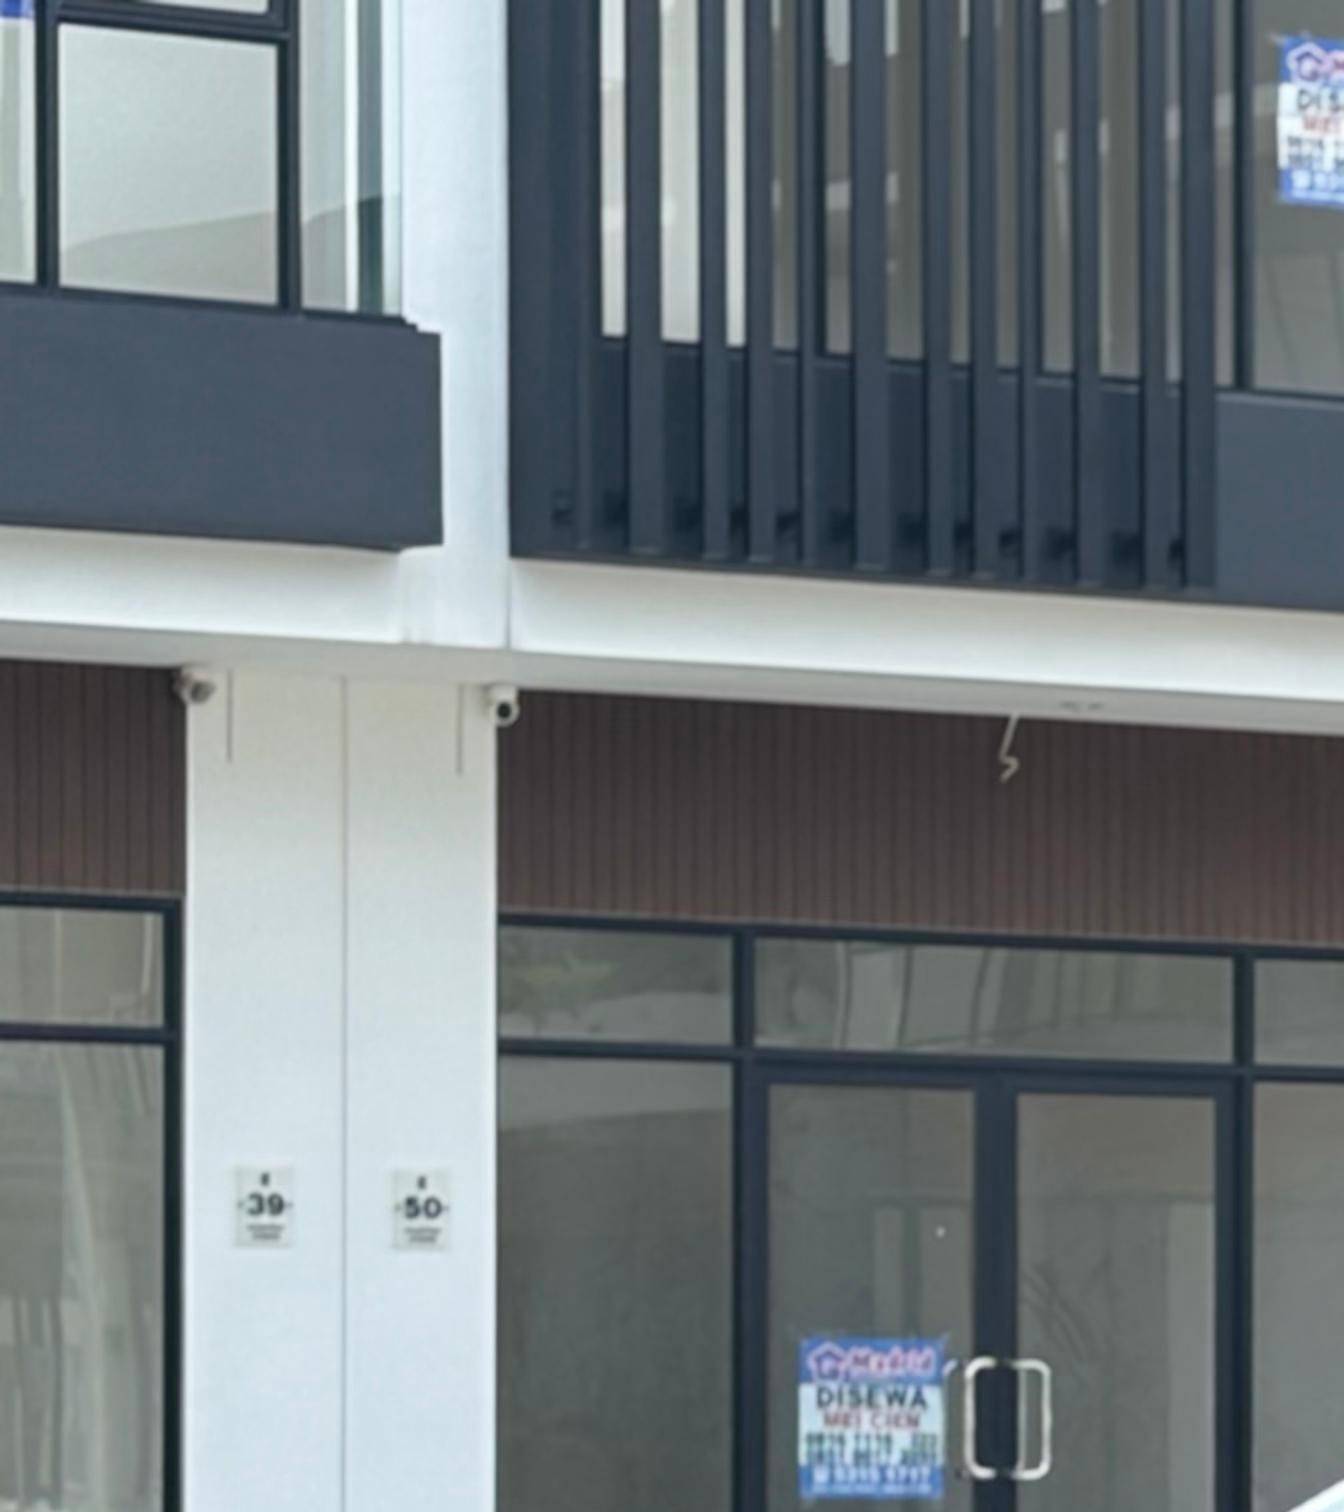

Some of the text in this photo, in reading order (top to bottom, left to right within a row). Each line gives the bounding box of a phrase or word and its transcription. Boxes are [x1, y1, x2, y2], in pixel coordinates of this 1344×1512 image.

[247, 1192, 285, 1217] 39
[404, 1196, 442, 1219] 50
[816, 1386, 928, 1409] DISEWA
